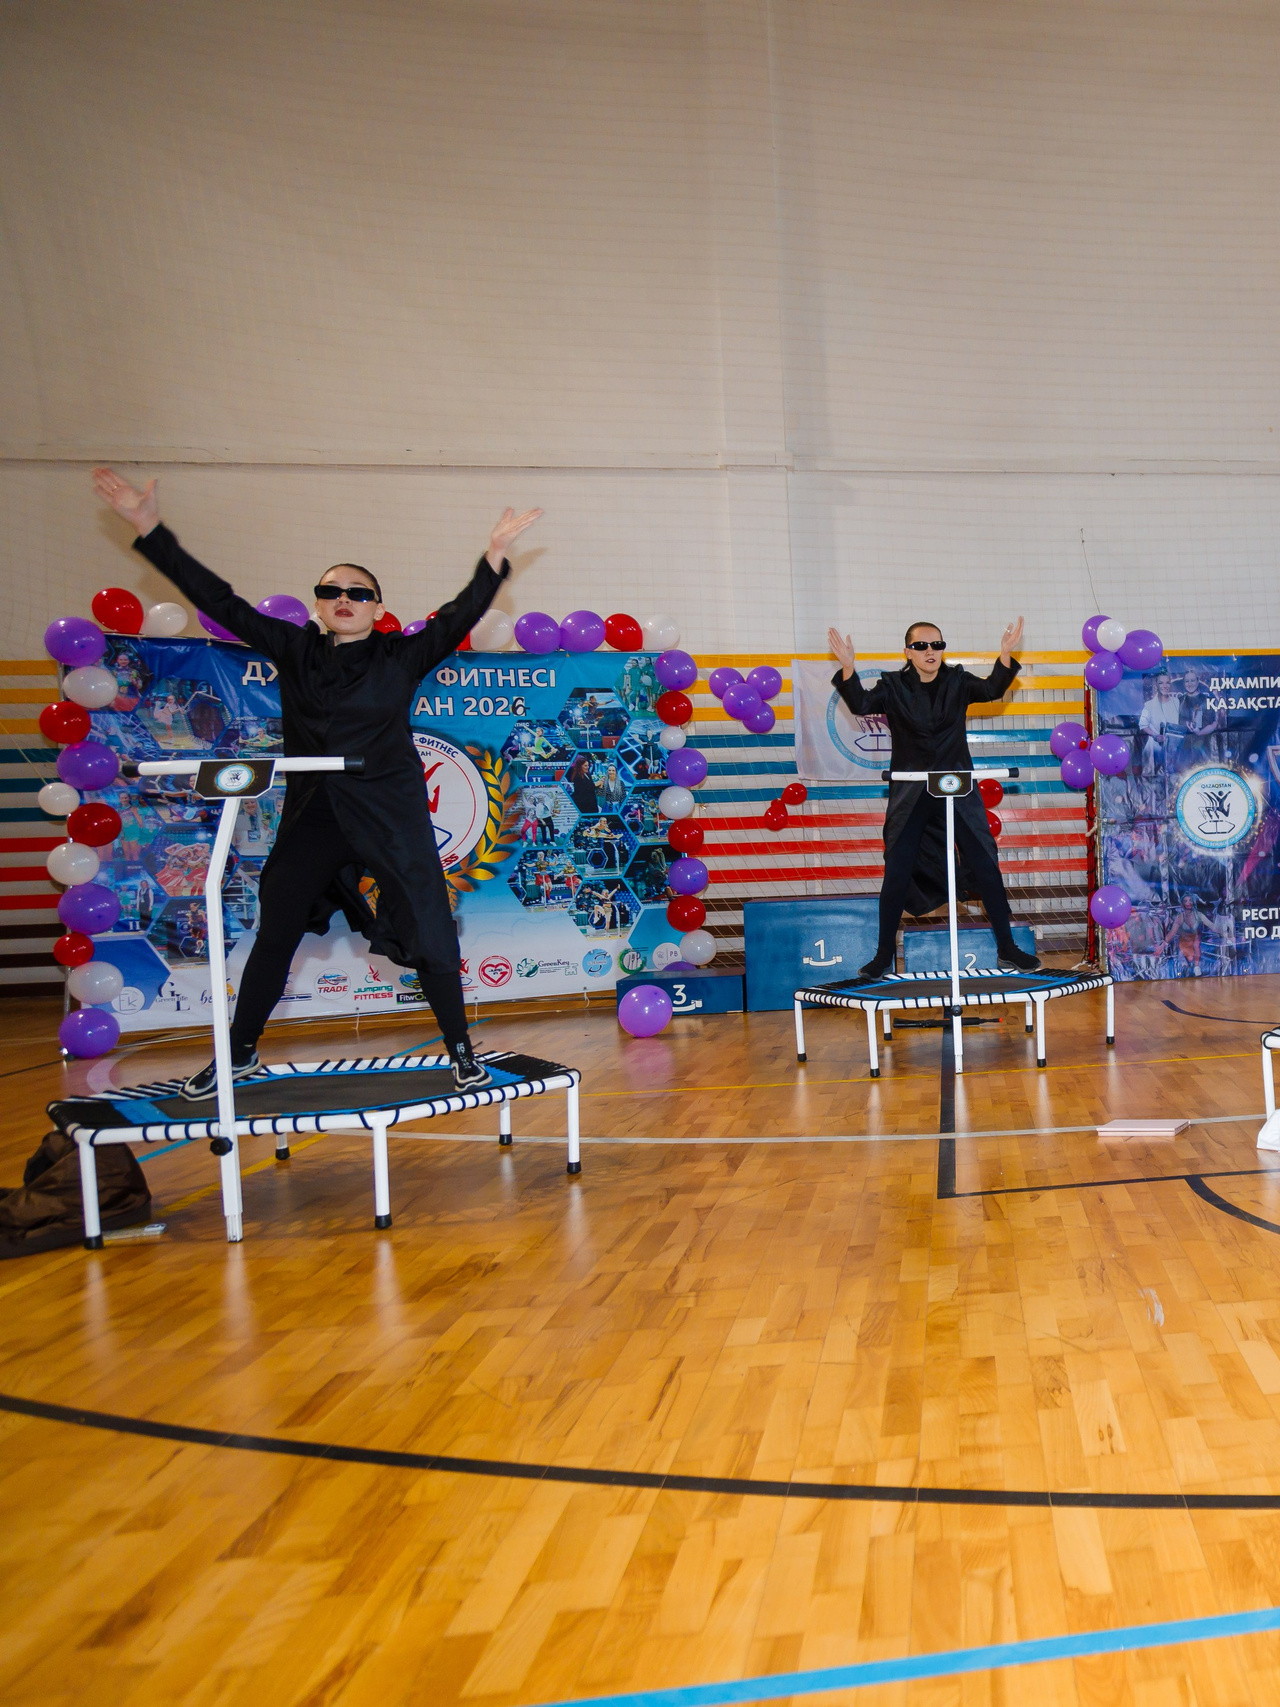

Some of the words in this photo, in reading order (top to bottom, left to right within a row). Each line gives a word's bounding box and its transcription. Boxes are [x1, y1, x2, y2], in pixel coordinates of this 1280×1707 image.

[436, 668, 556, 688] ФИТНЕСІ
[413, 696, 454, 716] АН
[463, 696, 526, 717] 2026
[414, 736, 459, 758] -ФИТНЕС
[1244, 926, 1268, 939] ПО
[814, 939, 825, 960] 1
[963, 953, 978, 971] 2
[317, 985, 349, 993] TRADE
[673, 984, 687, 1005] 3
